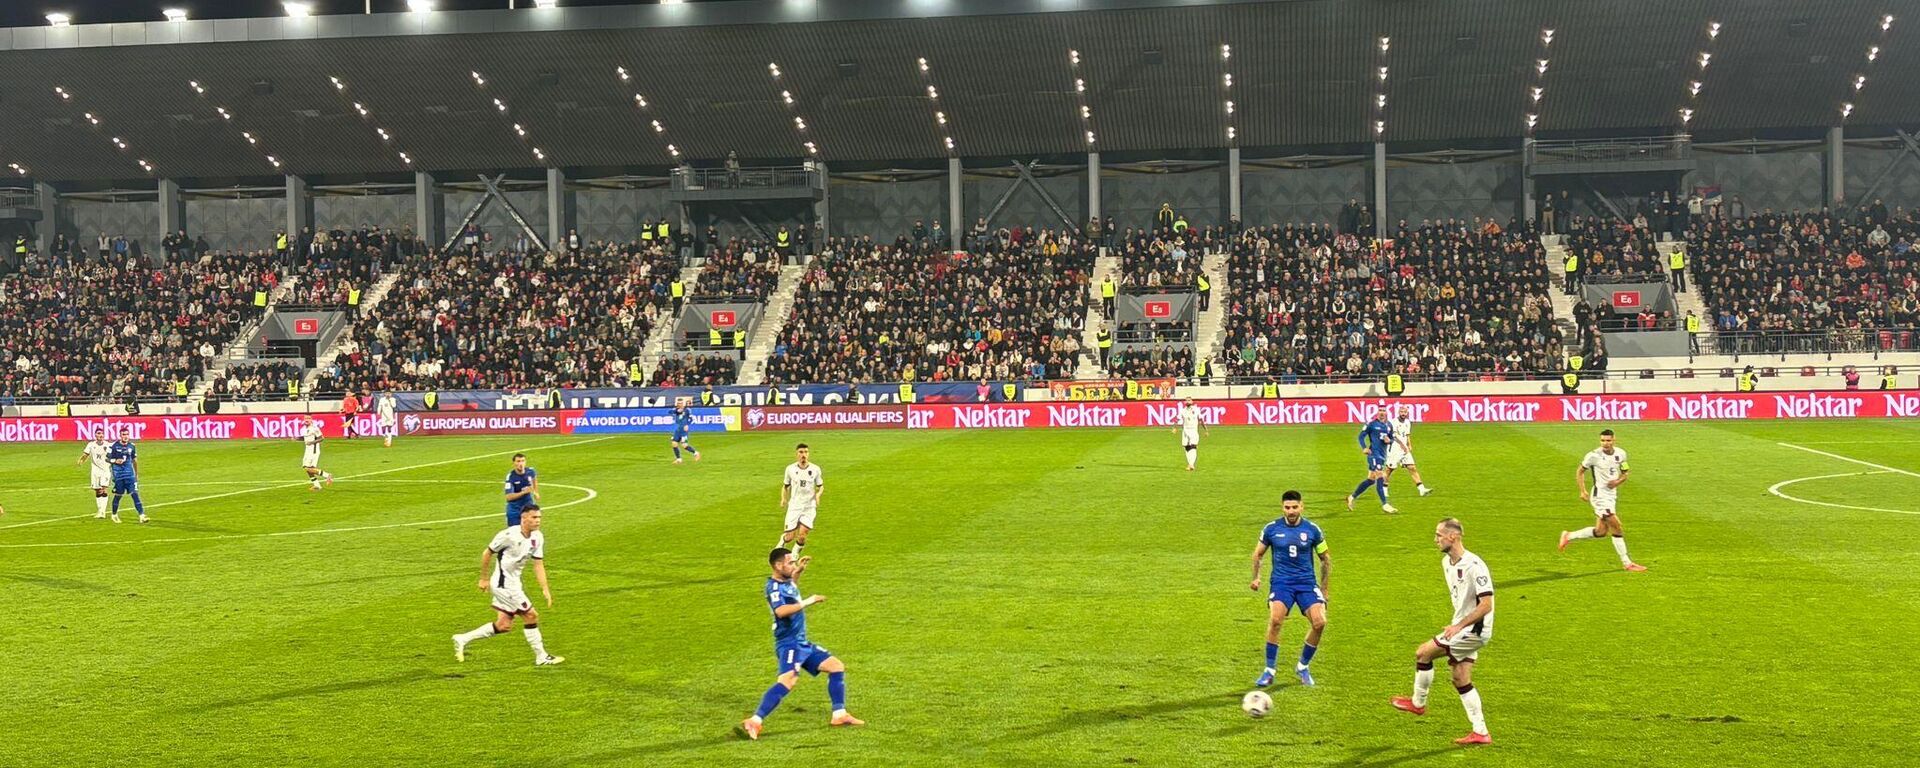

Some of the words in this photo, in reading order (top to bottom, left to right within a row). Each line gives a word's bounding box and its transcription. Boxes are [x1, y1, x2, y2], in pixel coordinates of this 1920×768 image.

[1069, 383, 1156, 400] БЕРАЕ
[767, 412, 831, 424] EUROPEAN
[835, 410, 904, 424] QUALIFIERS
[953, 404, 1030, 428] Nektar
[1046, 403, 1126, 427] Nektar
[1145, 401, 1226, 426] Nekar
[1245, 400, 1328, 424] Nektar
[1448, 397, 1540, 422] Nektar
[1560, 395, 1647, 420] Nektar
[1665, 394, 1753, 419] Nektar
[1774, 392, 1863, 418] Nektar
[162, 415, 236, 439] Nektar
[423, 418, 486, 430] EUROPEAN
[489, 416, 556, 429] QUALIFIERS
[566, 416, 589, 427] FIFA
[590, 415, 629, 427] WORLD
[630, 415, 652, 426] CUP
[689, 414, 736, 425] ALIFIERS
[1289, 545, 1298, 558] 9
